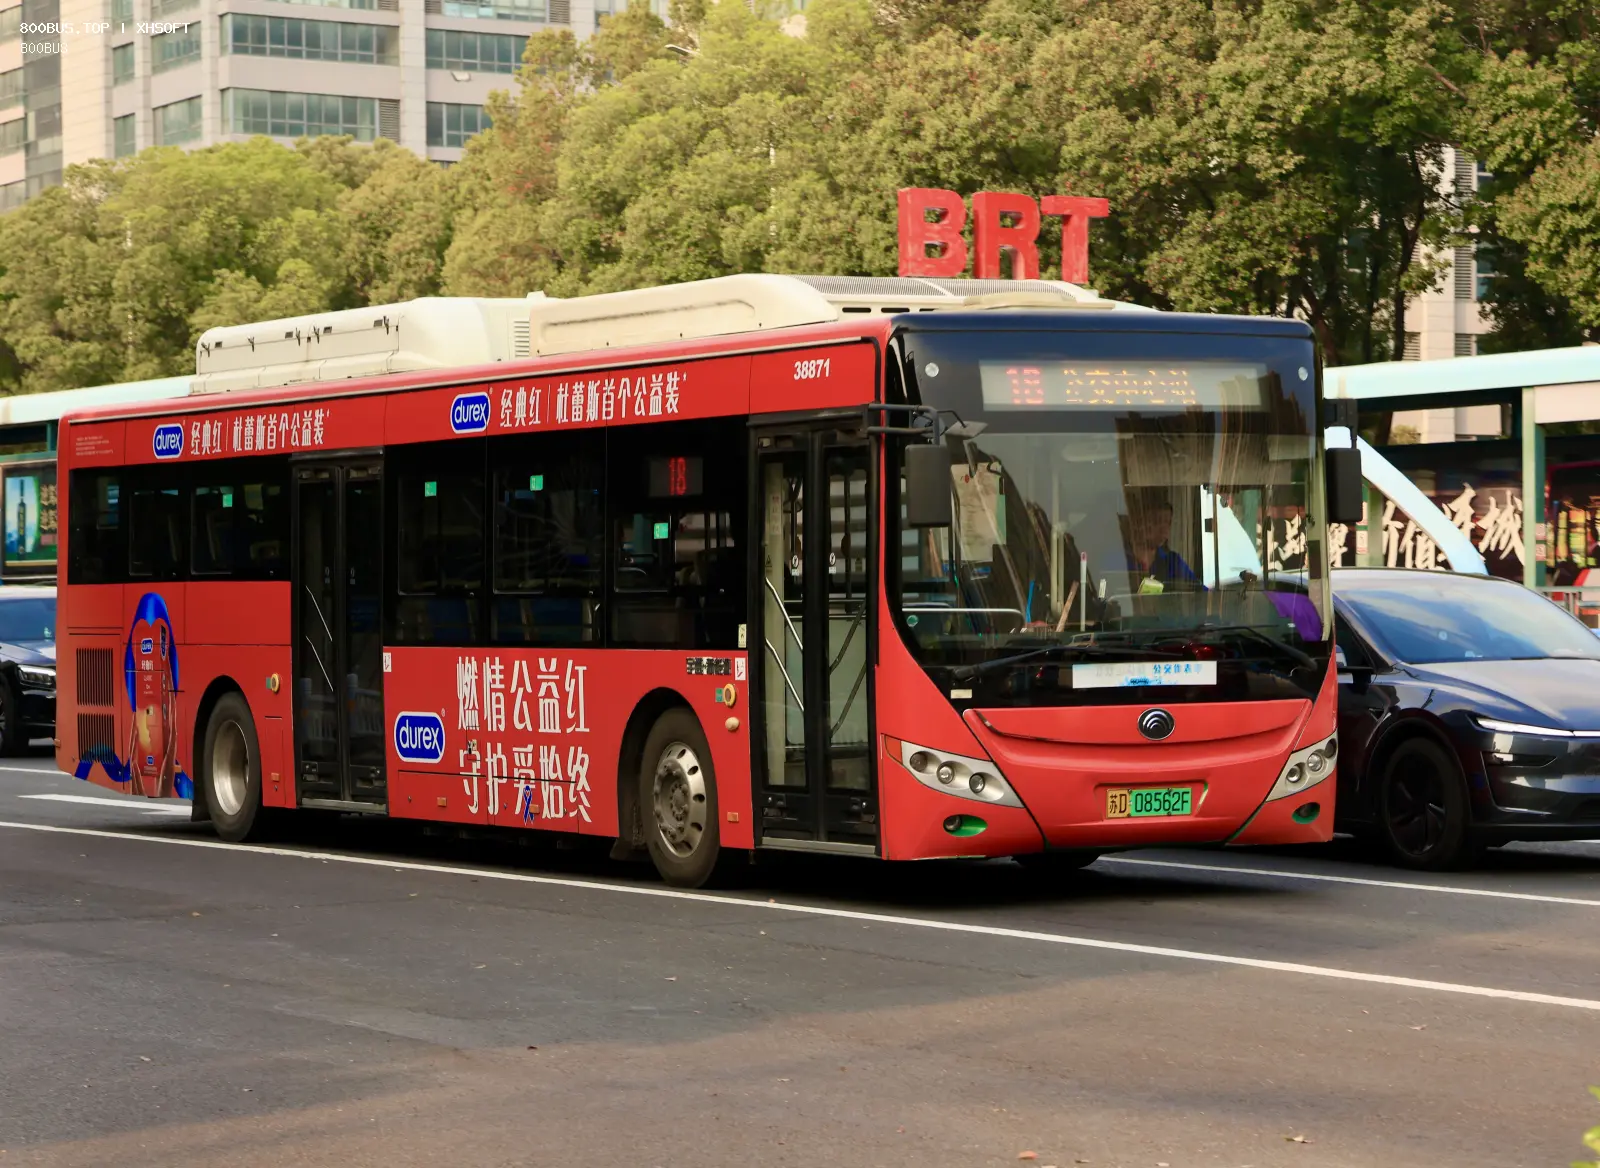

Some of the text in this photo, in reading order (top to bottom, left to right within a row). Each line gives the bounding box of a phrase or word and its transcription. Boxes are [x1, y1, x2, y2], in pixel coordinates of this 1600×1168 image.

[897, 187, 1109, 284] BRT
[793, 358, 831, 380] 38871
[453, 398, 488, 427] durex
[499, 386, 543, 428] 经典红
[155, 427, 183, 452] durex
[190, 419, 223, 456] 经典红
[668, 457, 687, 496] 18
[456, 656, 591, 734] 燃情公益红
[399, 718, 442, 754] durex
[458, 741, 593, 823] 守护爱始终
